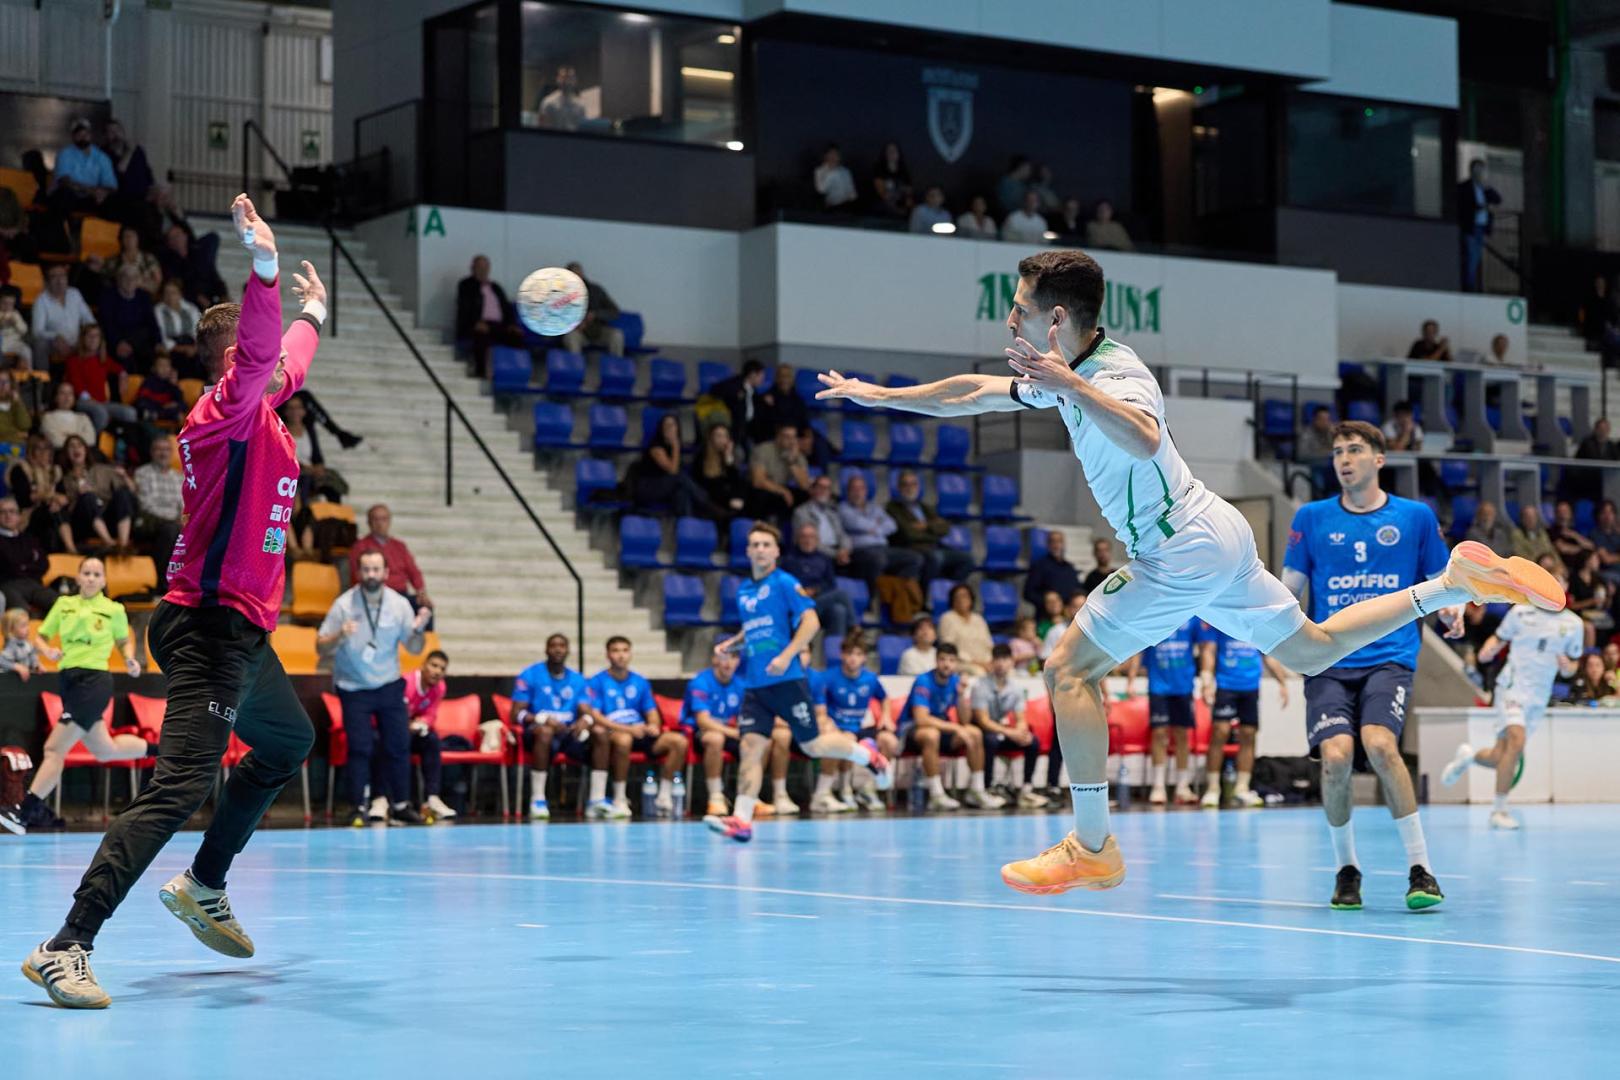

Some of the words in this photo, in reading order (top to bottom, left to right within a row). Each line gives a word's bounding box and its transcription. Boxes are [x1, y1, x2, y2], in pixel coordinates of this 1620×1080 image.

[424, 207, 446, 238] A
[1354, 541, 1367, 562] 3
[208, 701, 220, 714] EL
